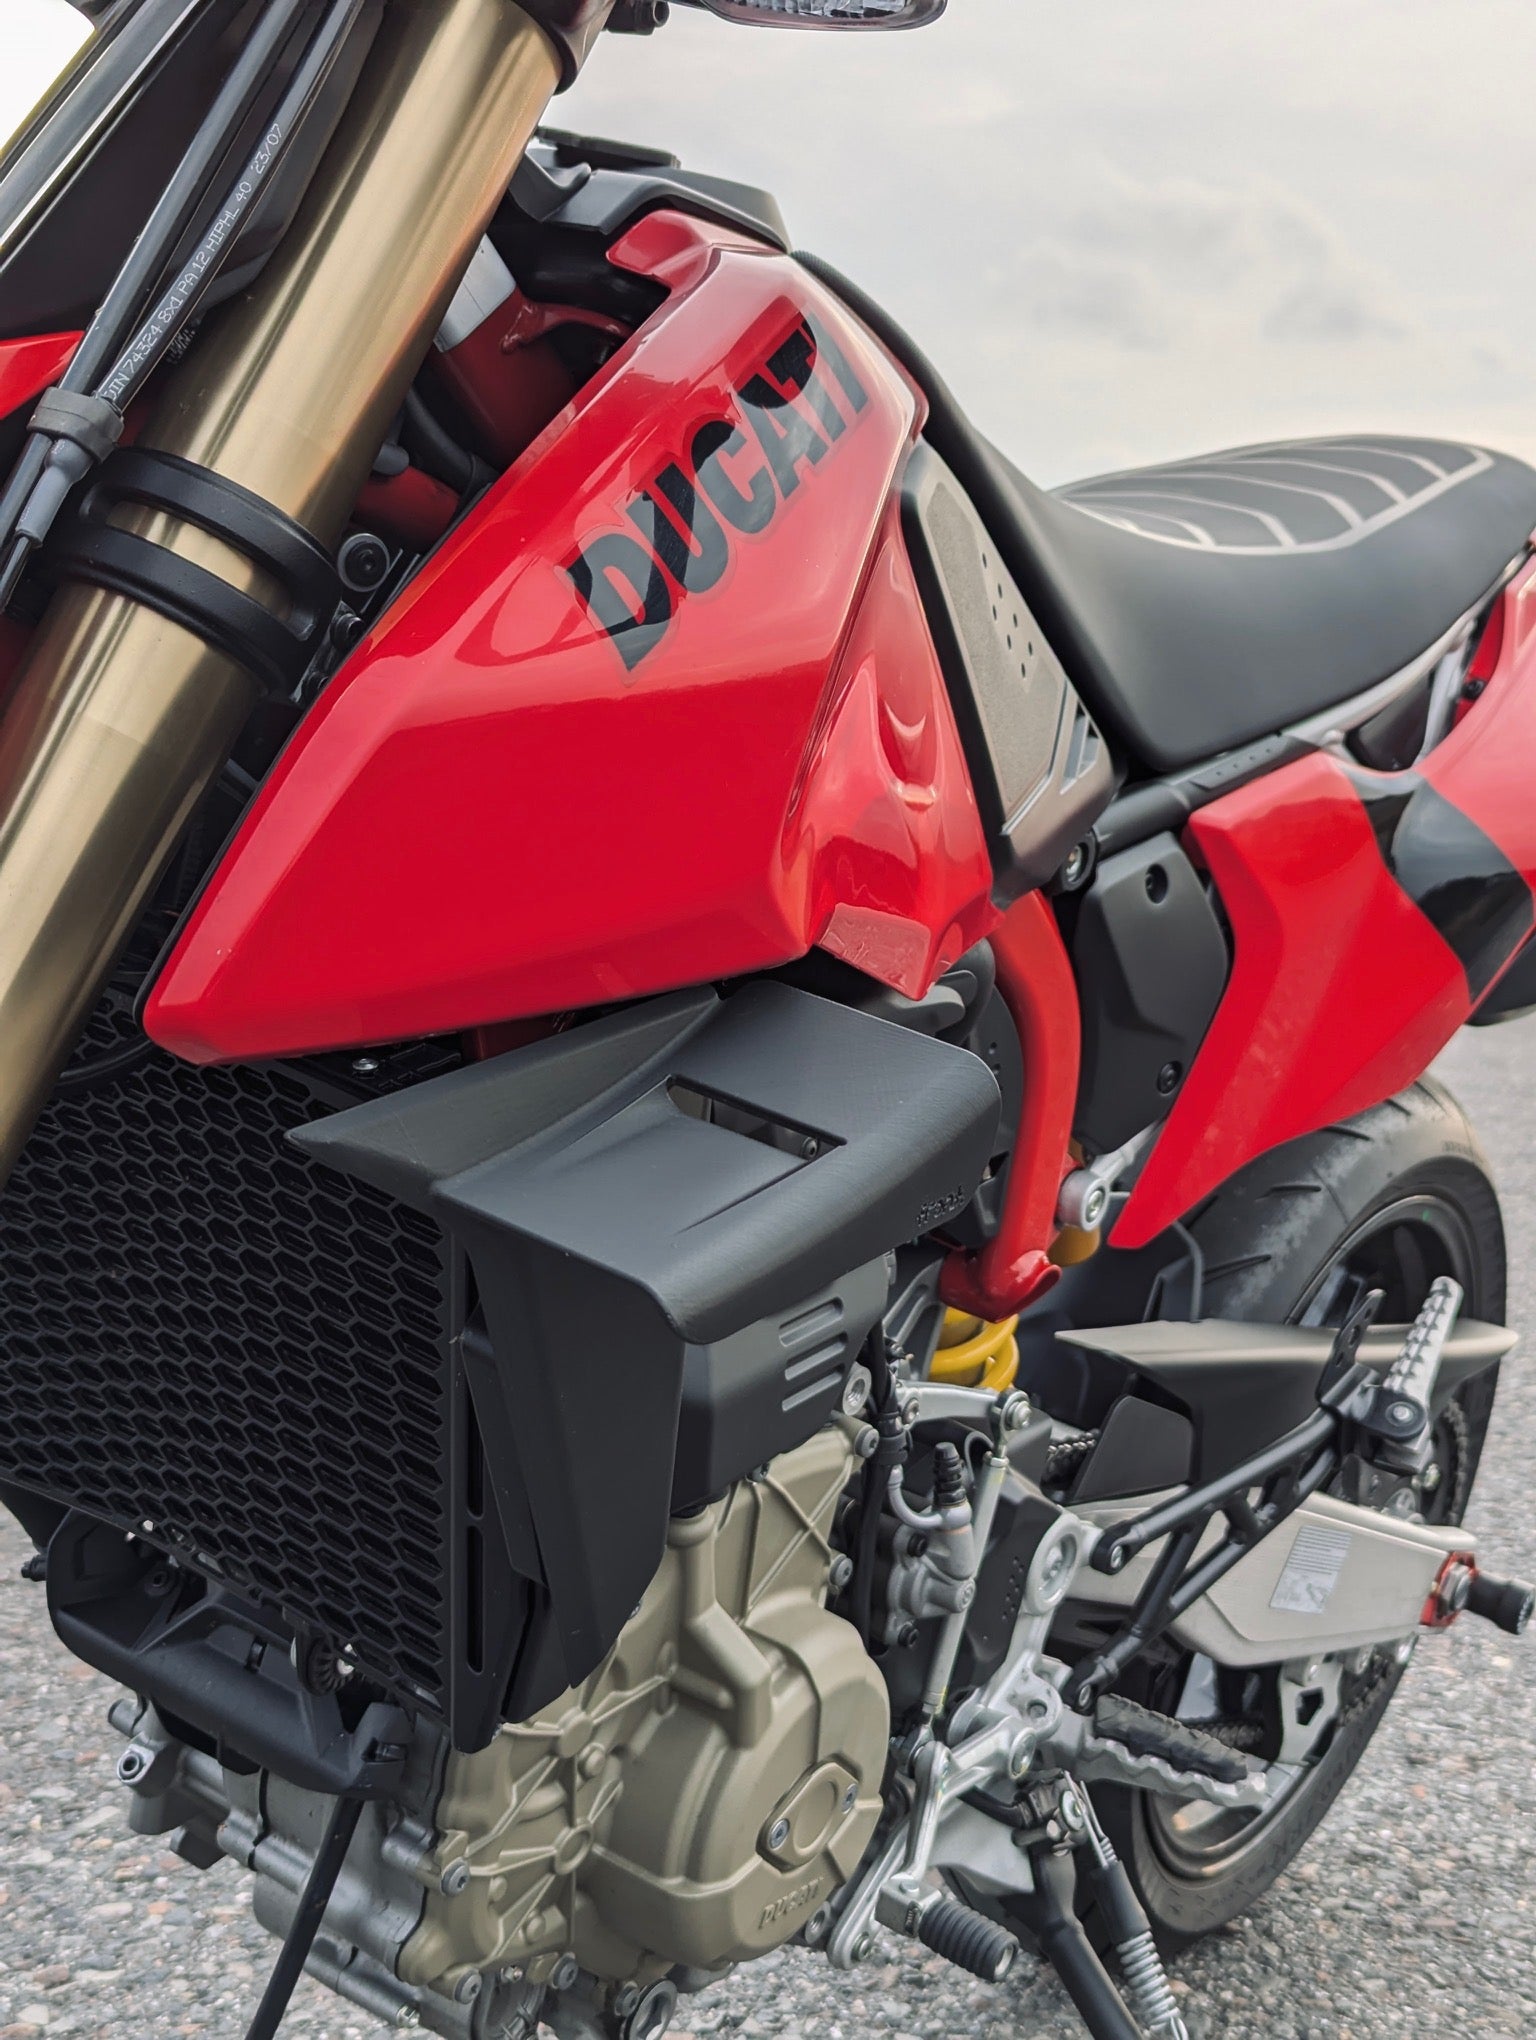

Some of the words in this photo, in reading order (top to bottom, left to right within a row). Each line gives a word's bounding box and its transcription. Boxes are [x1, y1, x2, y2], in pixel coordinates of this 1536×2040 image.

[122, 324, 163, 374] 74324
[178, 272, 199, 295] PA
[192, 251, 210, 273] 12
[206, 207, 240, 252] HIPHL
[235, 181, 251, 202] 40
[251, 123, 282, 174] 23/07
[564, 310, 869, 673] DUCATI
